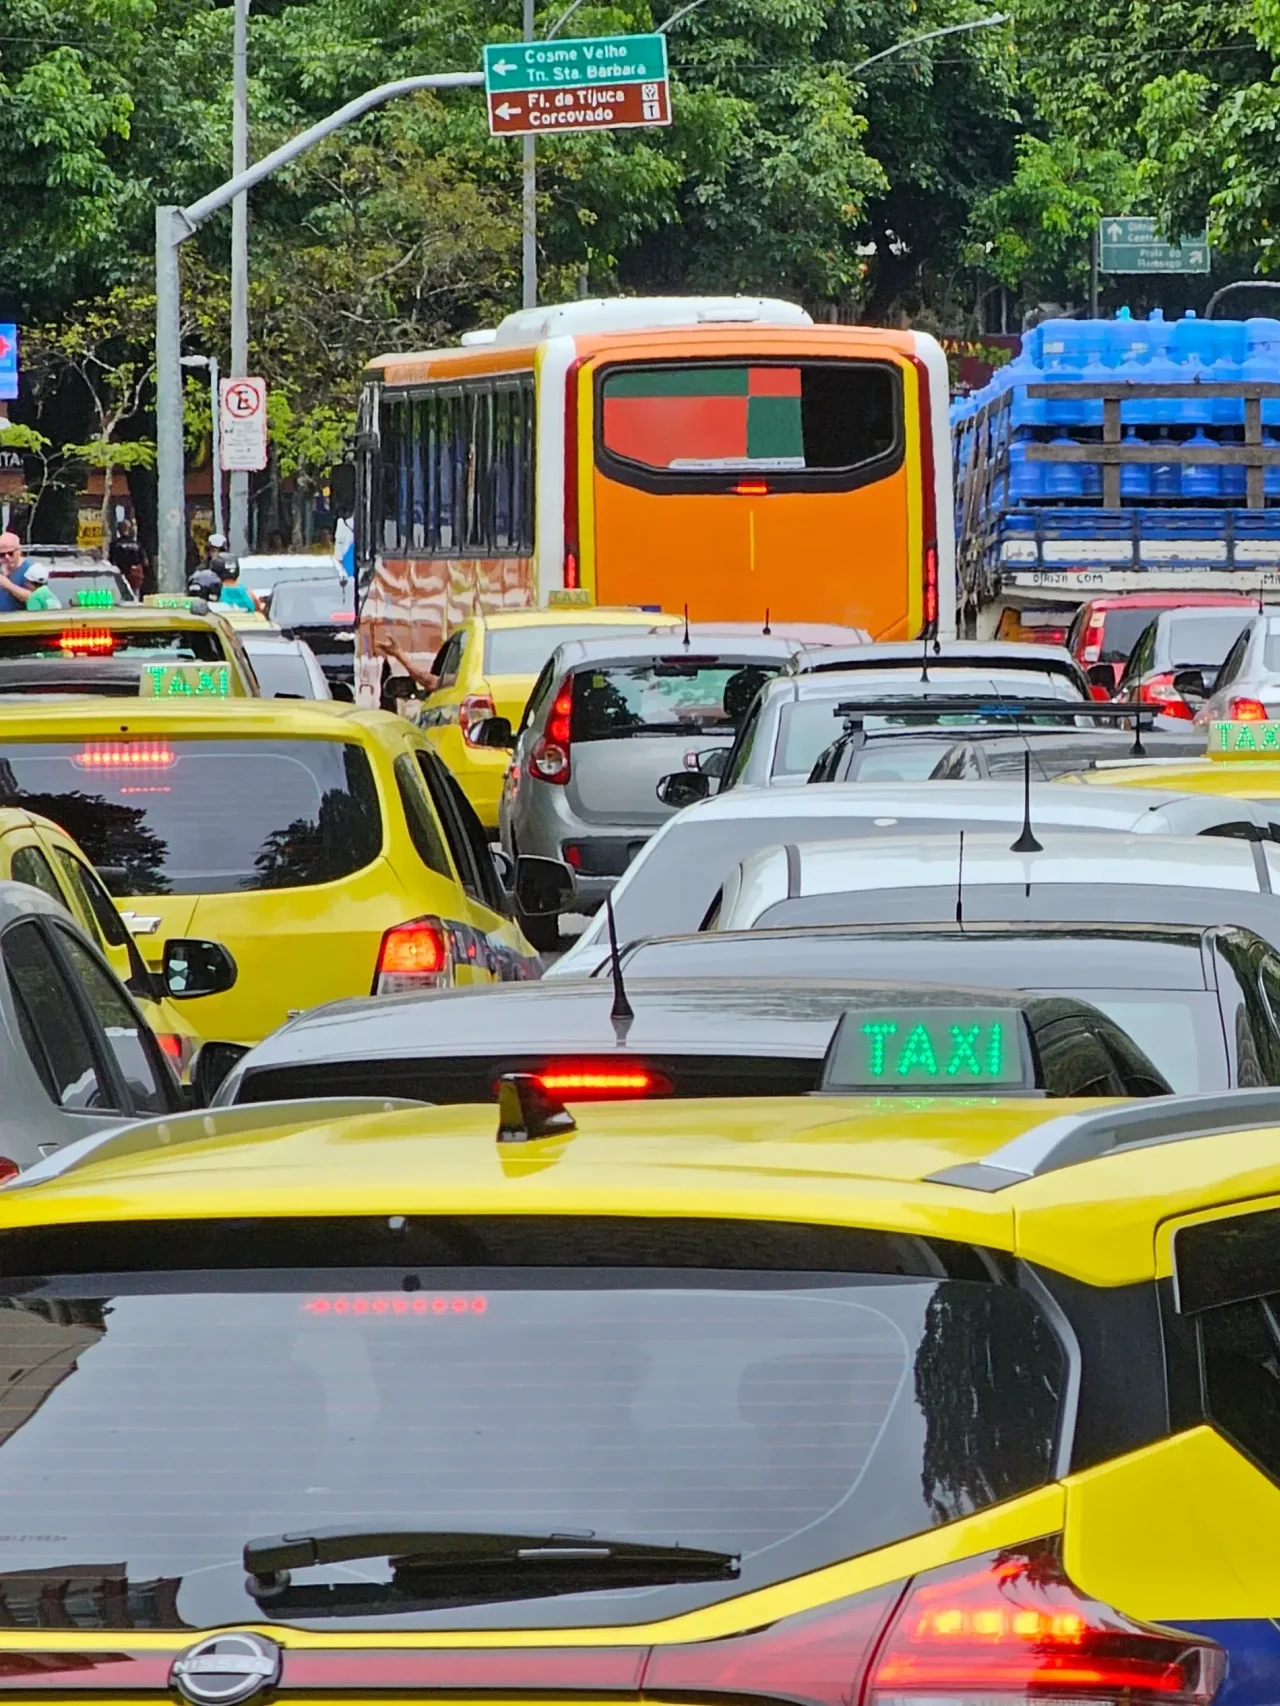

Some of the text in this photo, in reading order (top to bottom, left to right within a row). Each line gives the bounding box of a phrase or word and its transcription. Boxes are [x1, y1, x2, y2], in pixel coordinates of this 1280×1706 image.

[525, 45, 627, 63] Cosme Velho
[527, 69, 549, 82] Tn.
[553, 67, 583, 80] Sta.
[528, 90, 625, 108] Fl. da Tijuca
[529, 107, 613, 125] Corcovado
[1077, 574, 1103, 583] COM
[549, 590, 589, 604] TAXI
[147, 666, 228, 696] TAXI
[862, 1023, 1002, 1076] TAXI
[173, 1656, 274, 1675] NISSAN
